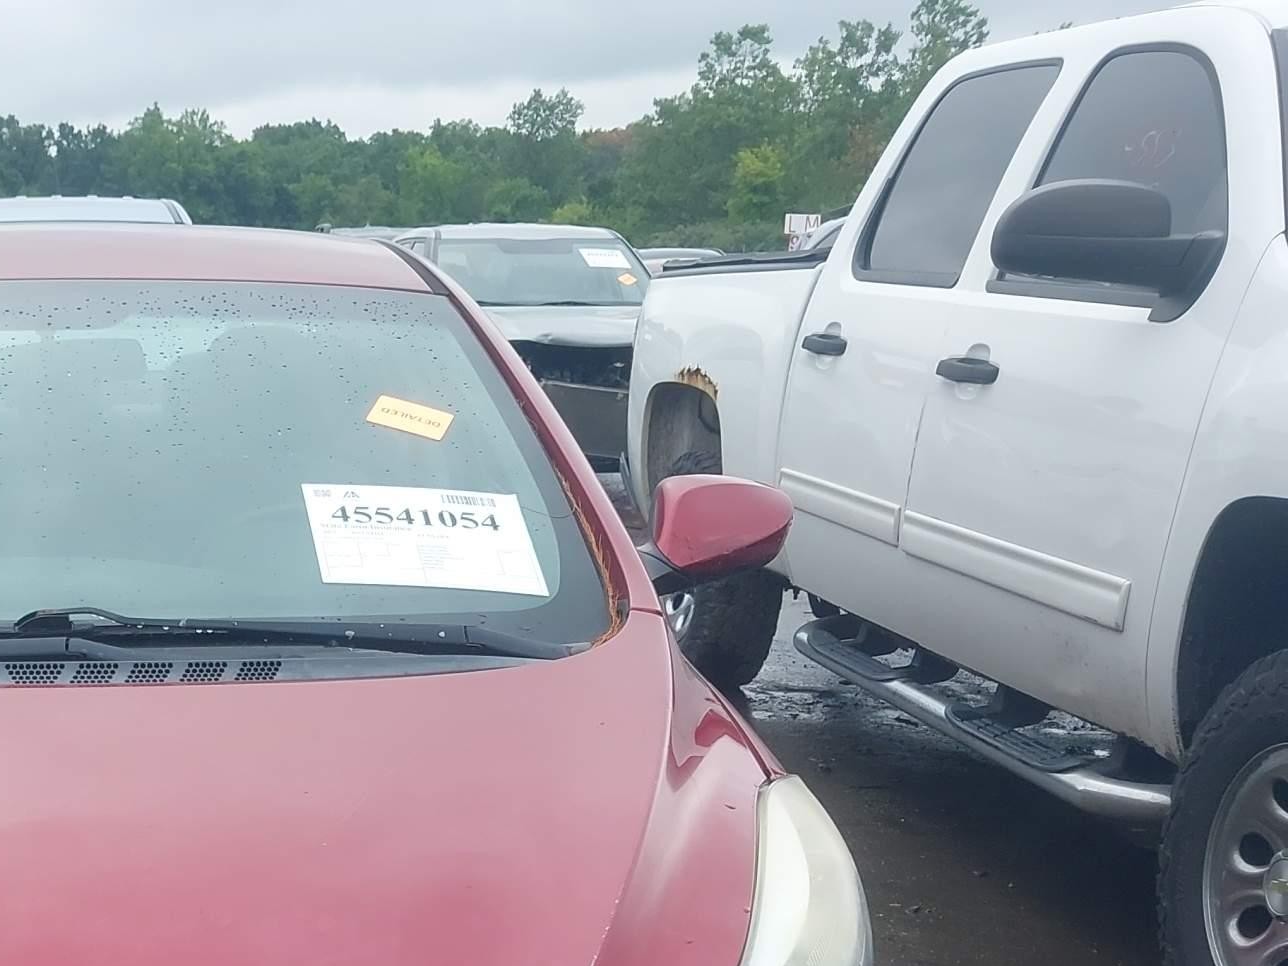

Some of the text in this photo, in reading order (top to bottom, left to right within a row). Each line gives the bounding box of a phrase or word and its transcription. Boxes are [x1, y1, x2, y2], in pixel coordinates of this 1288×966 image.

[788, 215, 797, 232] L
[381, 407, 441, 428] DETAILED
[331, 505, 500, 531] 45541054
